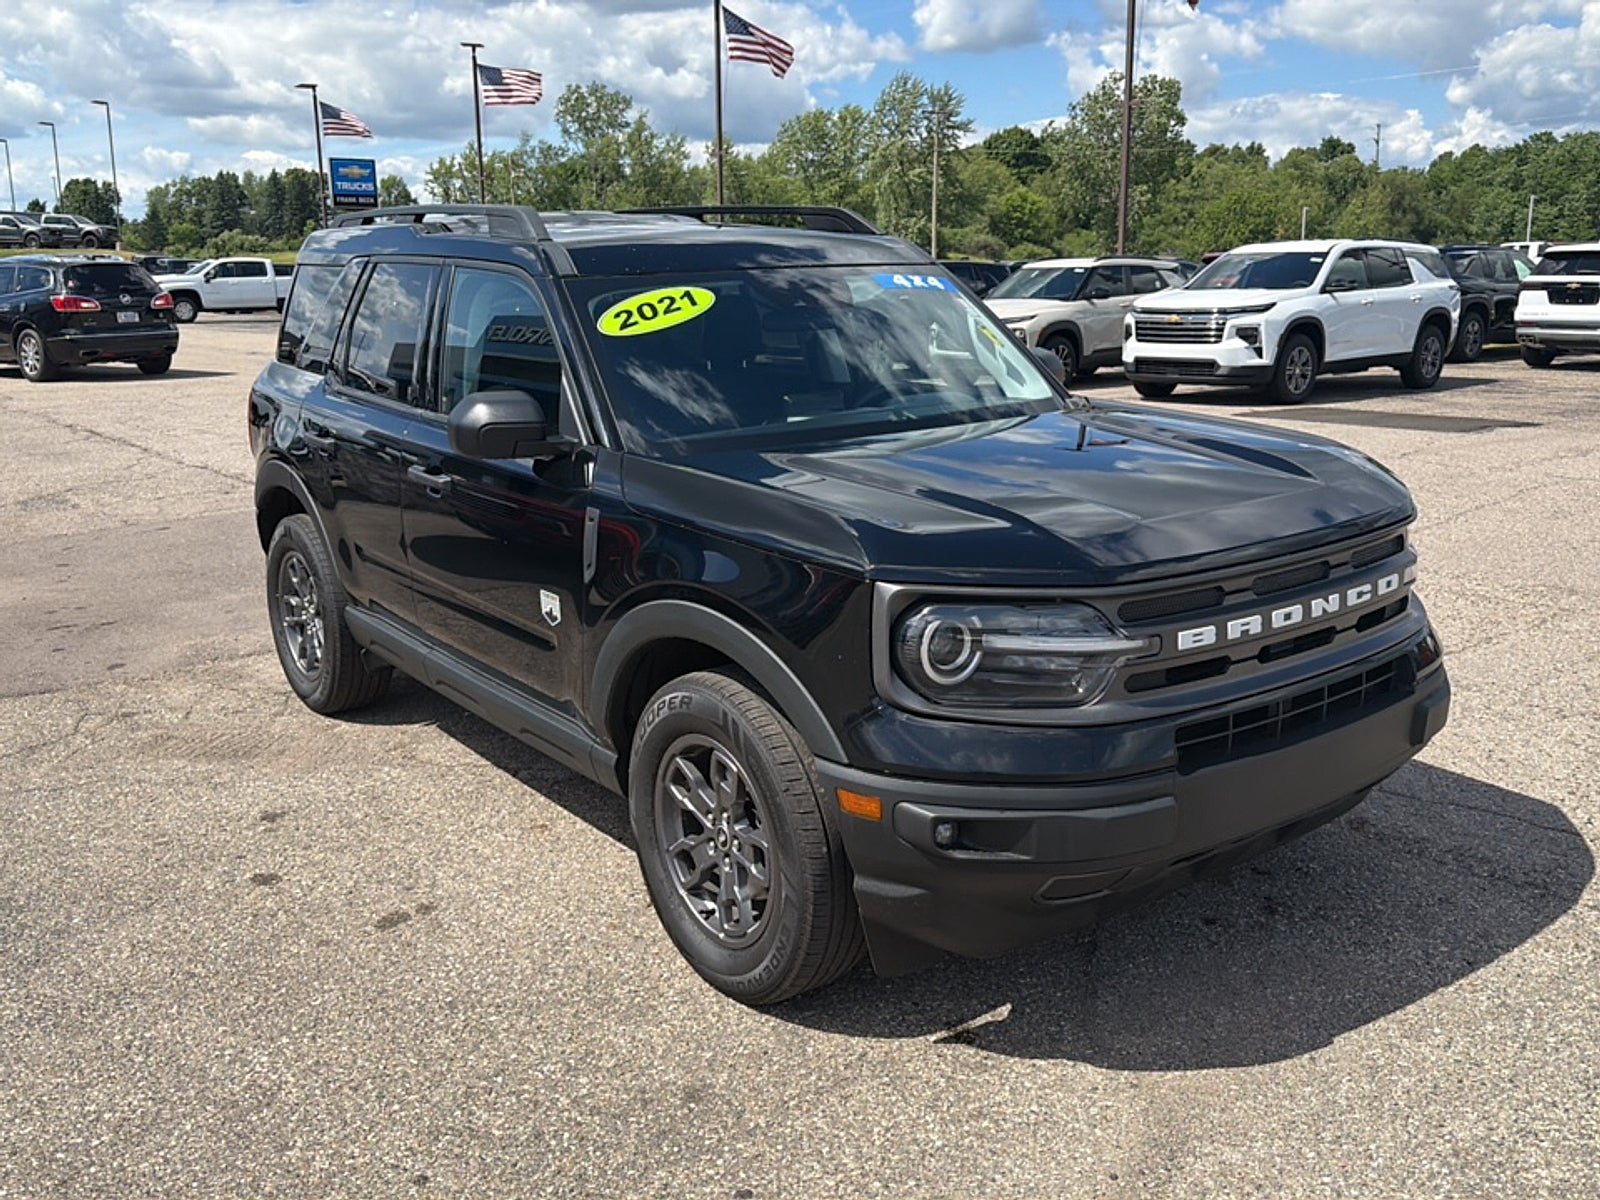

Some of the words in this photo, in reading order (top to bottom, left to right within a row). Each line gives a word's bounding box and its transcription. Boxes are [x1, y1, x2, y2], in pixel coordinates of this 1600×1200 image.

[335, 181, 375, 191] TRUCKS
[613, 289, 698, 331] 2021
[1177, 573, 1399, 651] BRONCO
